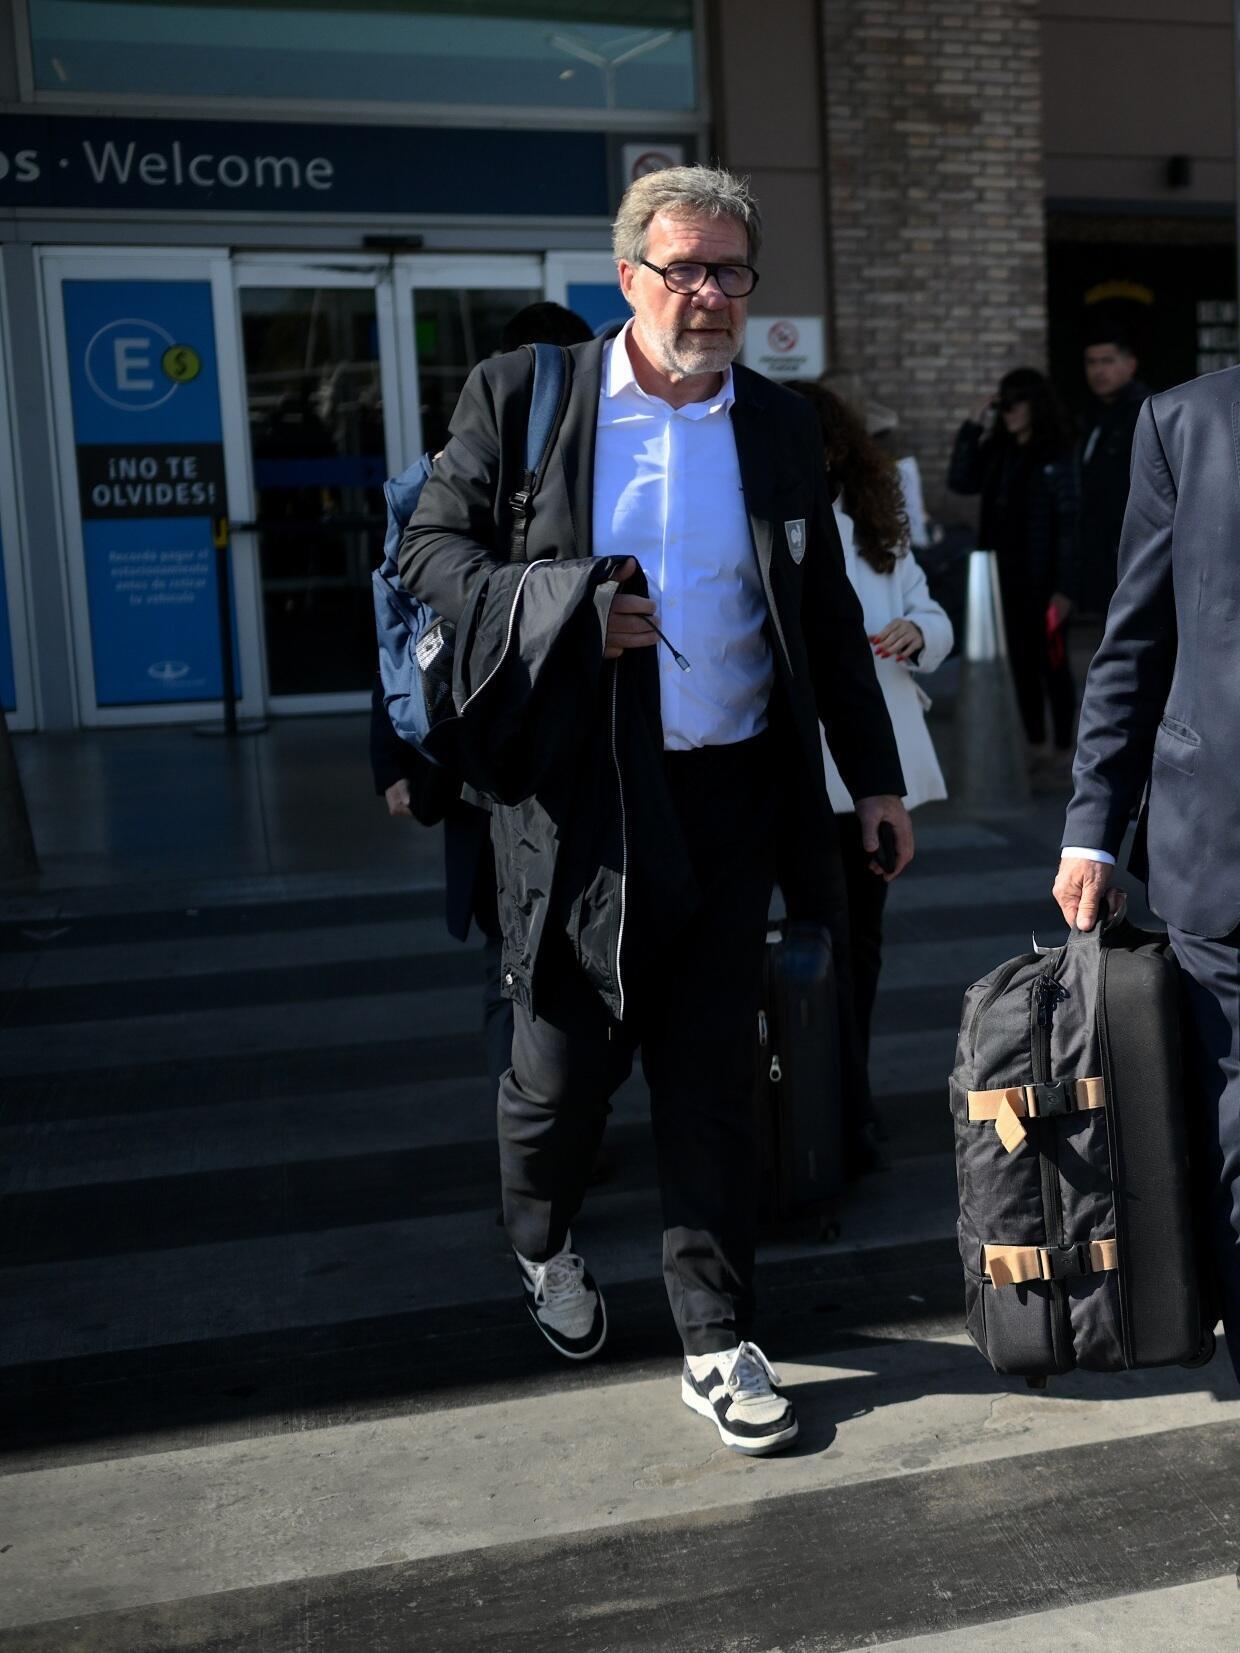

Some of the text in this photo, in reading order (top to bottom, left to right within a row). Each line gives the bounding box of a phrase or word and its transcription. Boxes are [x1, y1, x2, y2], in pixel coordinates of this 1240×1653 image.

[82, 140, 334, 190] Welcome
[113, 337, 154, 391] E
[108, 455, 198, 480] ¡NO TE
[91, 482, 216, 506] OLVIDES!
